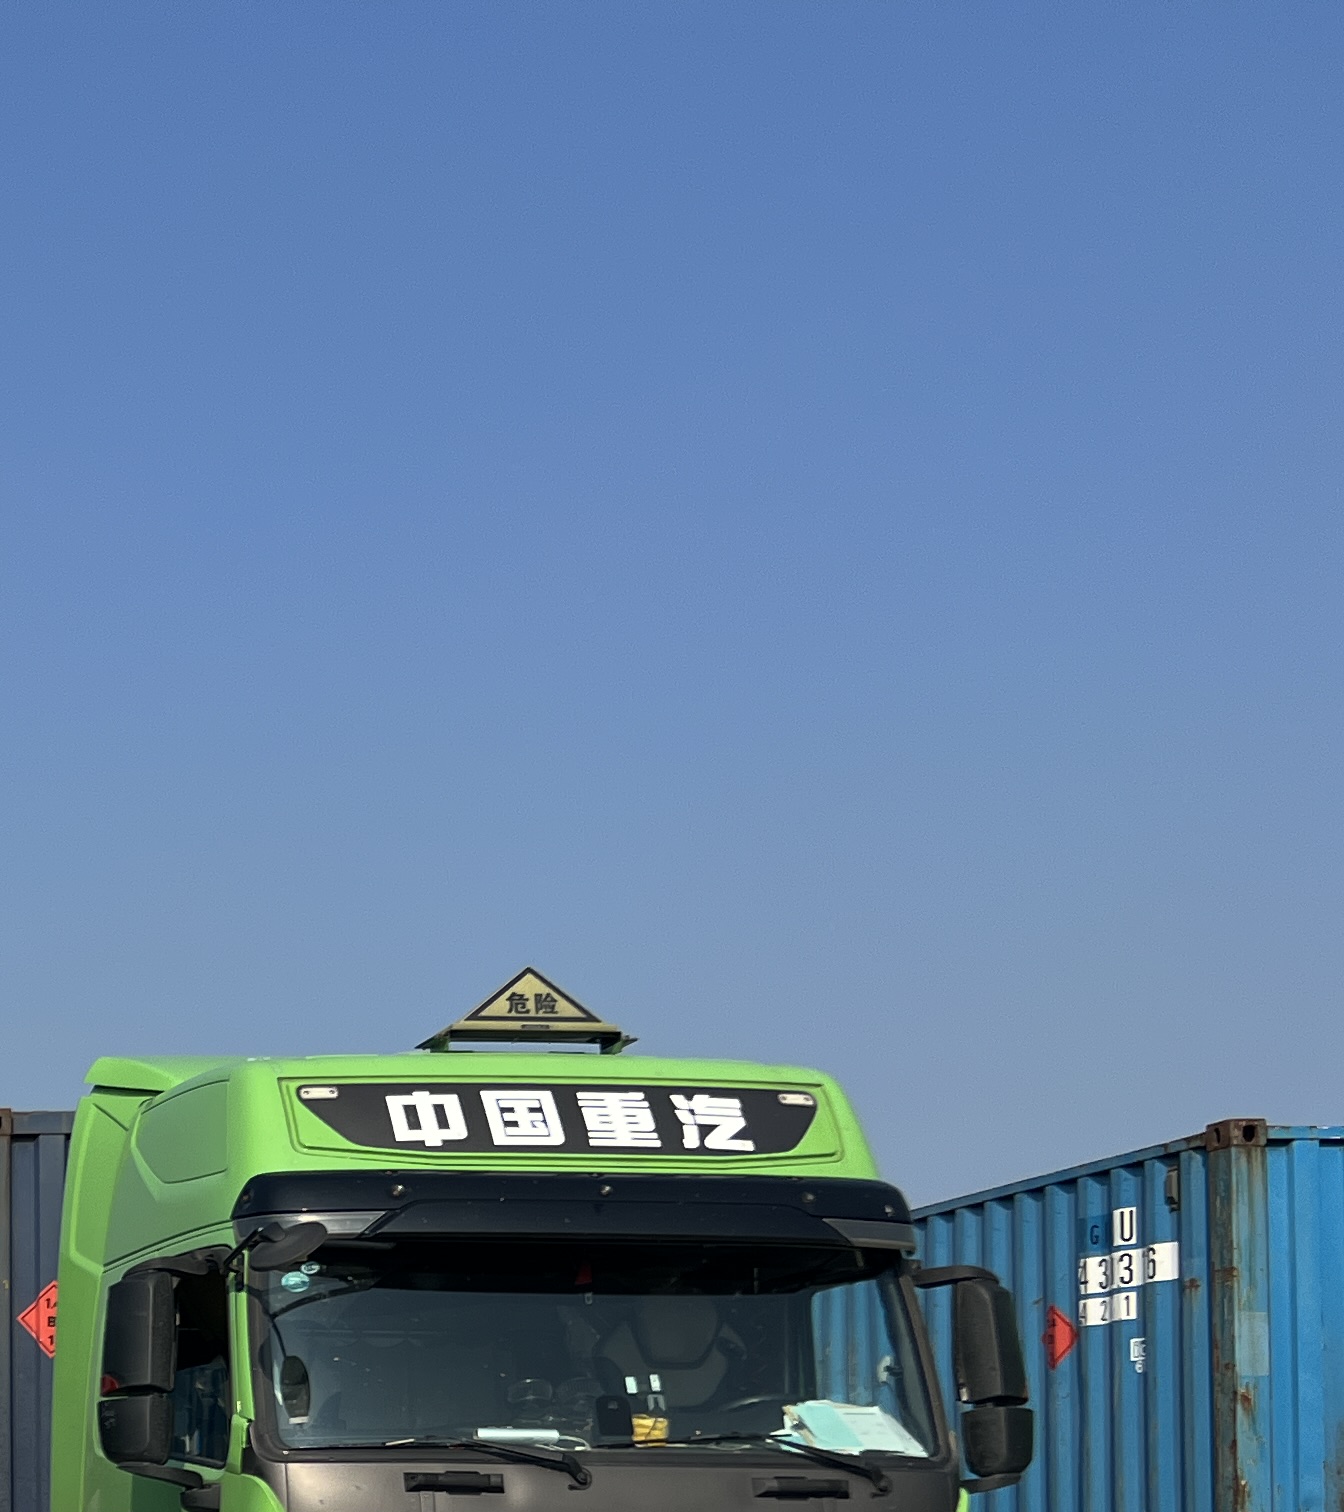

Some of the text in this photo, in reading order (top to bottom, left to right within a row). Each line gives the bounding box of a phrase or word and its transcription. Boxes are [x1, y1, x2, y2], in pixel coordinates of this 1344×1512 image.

[506, 992, 558, 1015] 危险
[385, 1090, 755, 1152] 中国重汽
